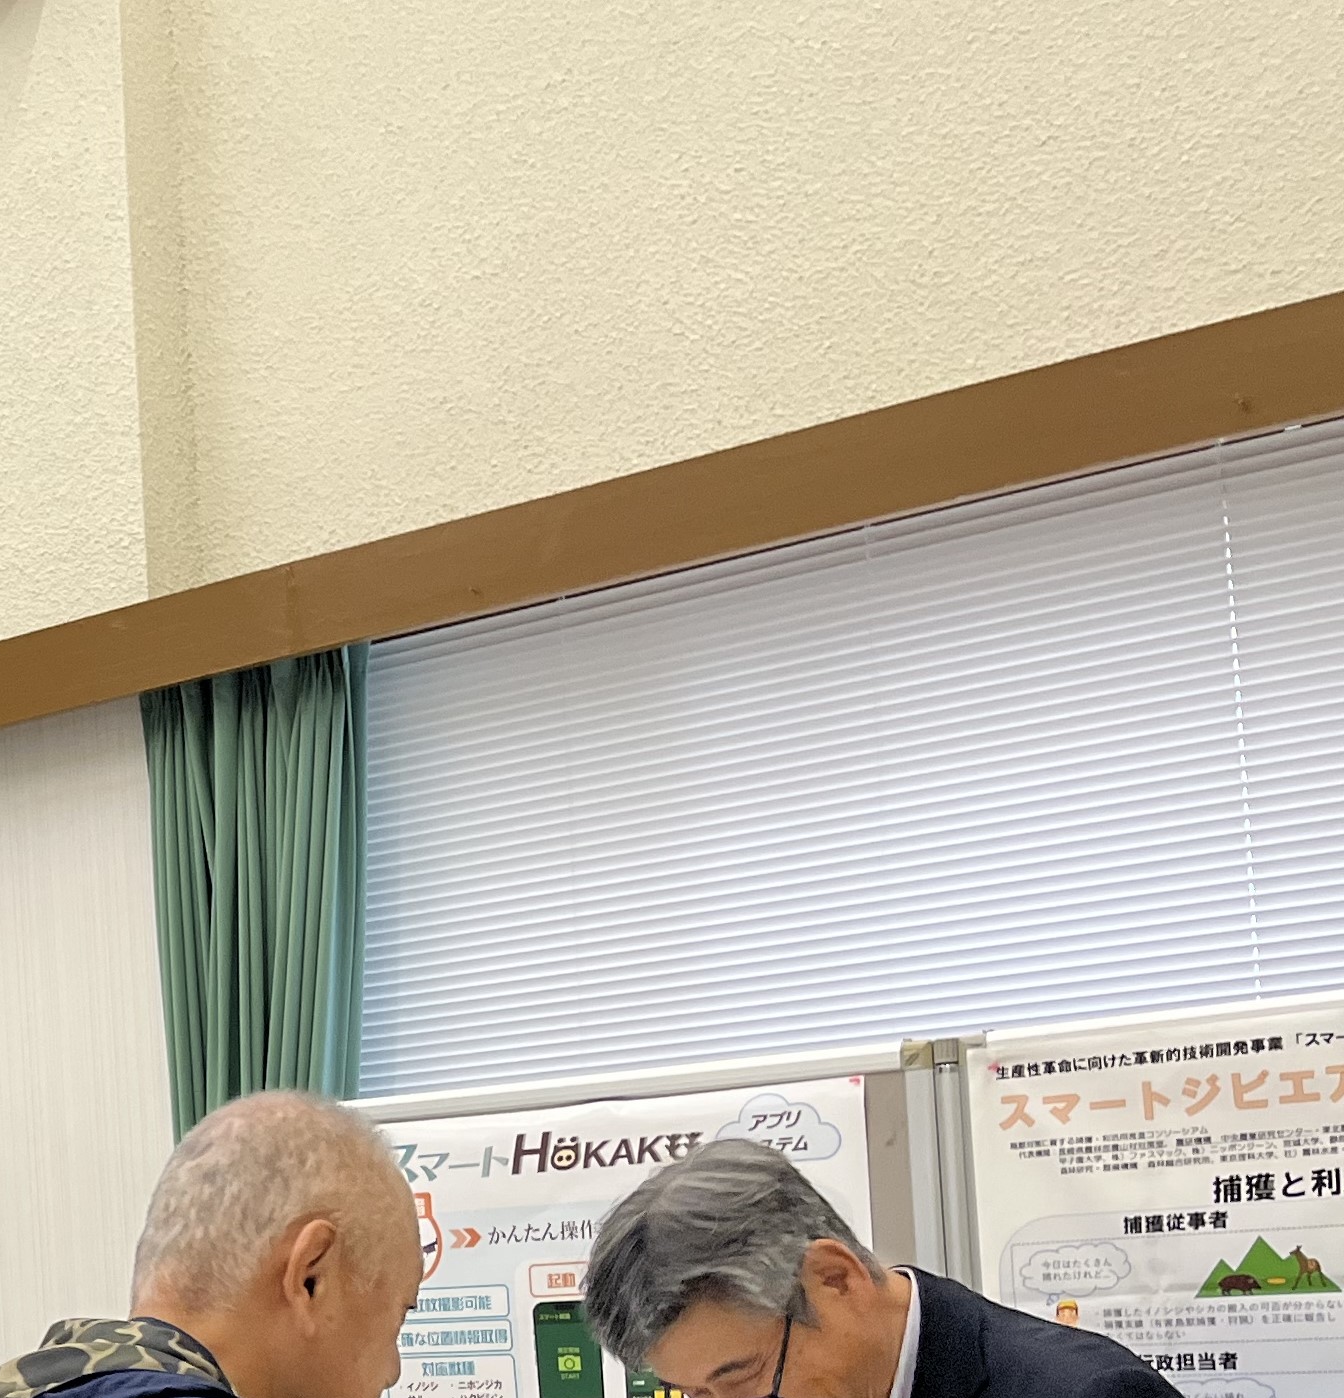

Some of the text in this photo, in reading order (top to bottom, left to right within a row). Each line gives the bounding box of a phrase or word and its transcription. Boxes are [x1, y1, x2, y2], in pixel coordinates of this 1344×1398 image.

[748, 1109, 802, 1131] アプリ
[1123, 1211, 1229, 1234] 捕獲従事者
